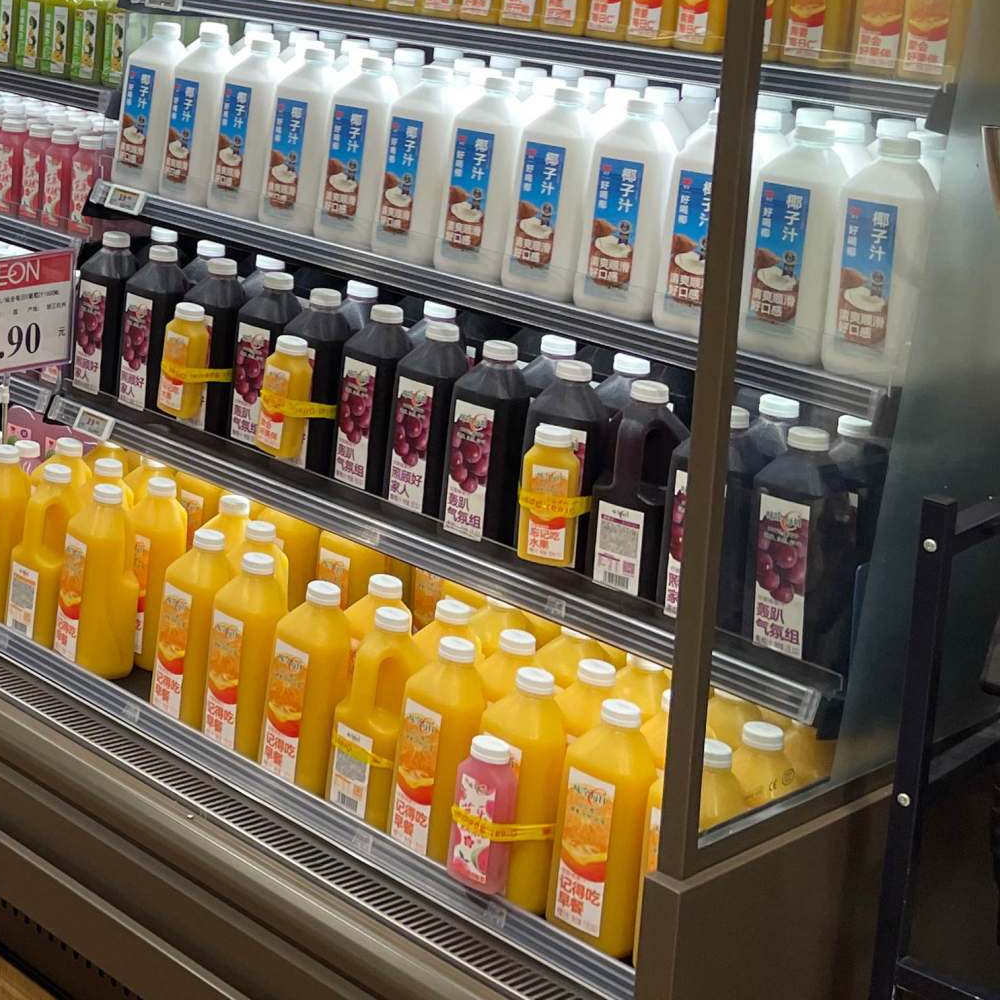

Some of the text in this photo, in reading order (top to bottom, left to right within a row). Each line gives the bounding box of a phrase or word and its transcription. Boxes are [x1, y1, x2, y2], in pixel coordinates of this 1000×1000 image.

[287, 106, 304, 145] 椰子汁
[347, 113, 363, 153] 椰子汁
[402, 125, 418, 167] 椰子汁
[470, 138, 489, 181] 椰子汁
[540, 152, 560, 196] 椰子汁
[617, 167, 637, 214] 椰子汁
[782, 194, 803, 243] 椰子汁
[868, 211, 890, 261] 椰子汁
[57, 327, 66, 337] 元
[391, 466, 423, 486] 照顾好
[391, 480, 409, 498] 家人
[448, 493, 469, 512] 轰趴
[447, 506, 481, 530] 气氛组
[756, 602, 784, 625] 轰趴
[755, 619, 800, 646] 气氛组
[265, 745, 283, 766] 早餐
[266, 733, 295, 758] 记得吃
[395, 814, 414, 837] 早餐
[396, 801, 428, 829] 记得吃
[557, 893, 585, 917] 早餐
[559, 878, 601, 908] 记得吃
